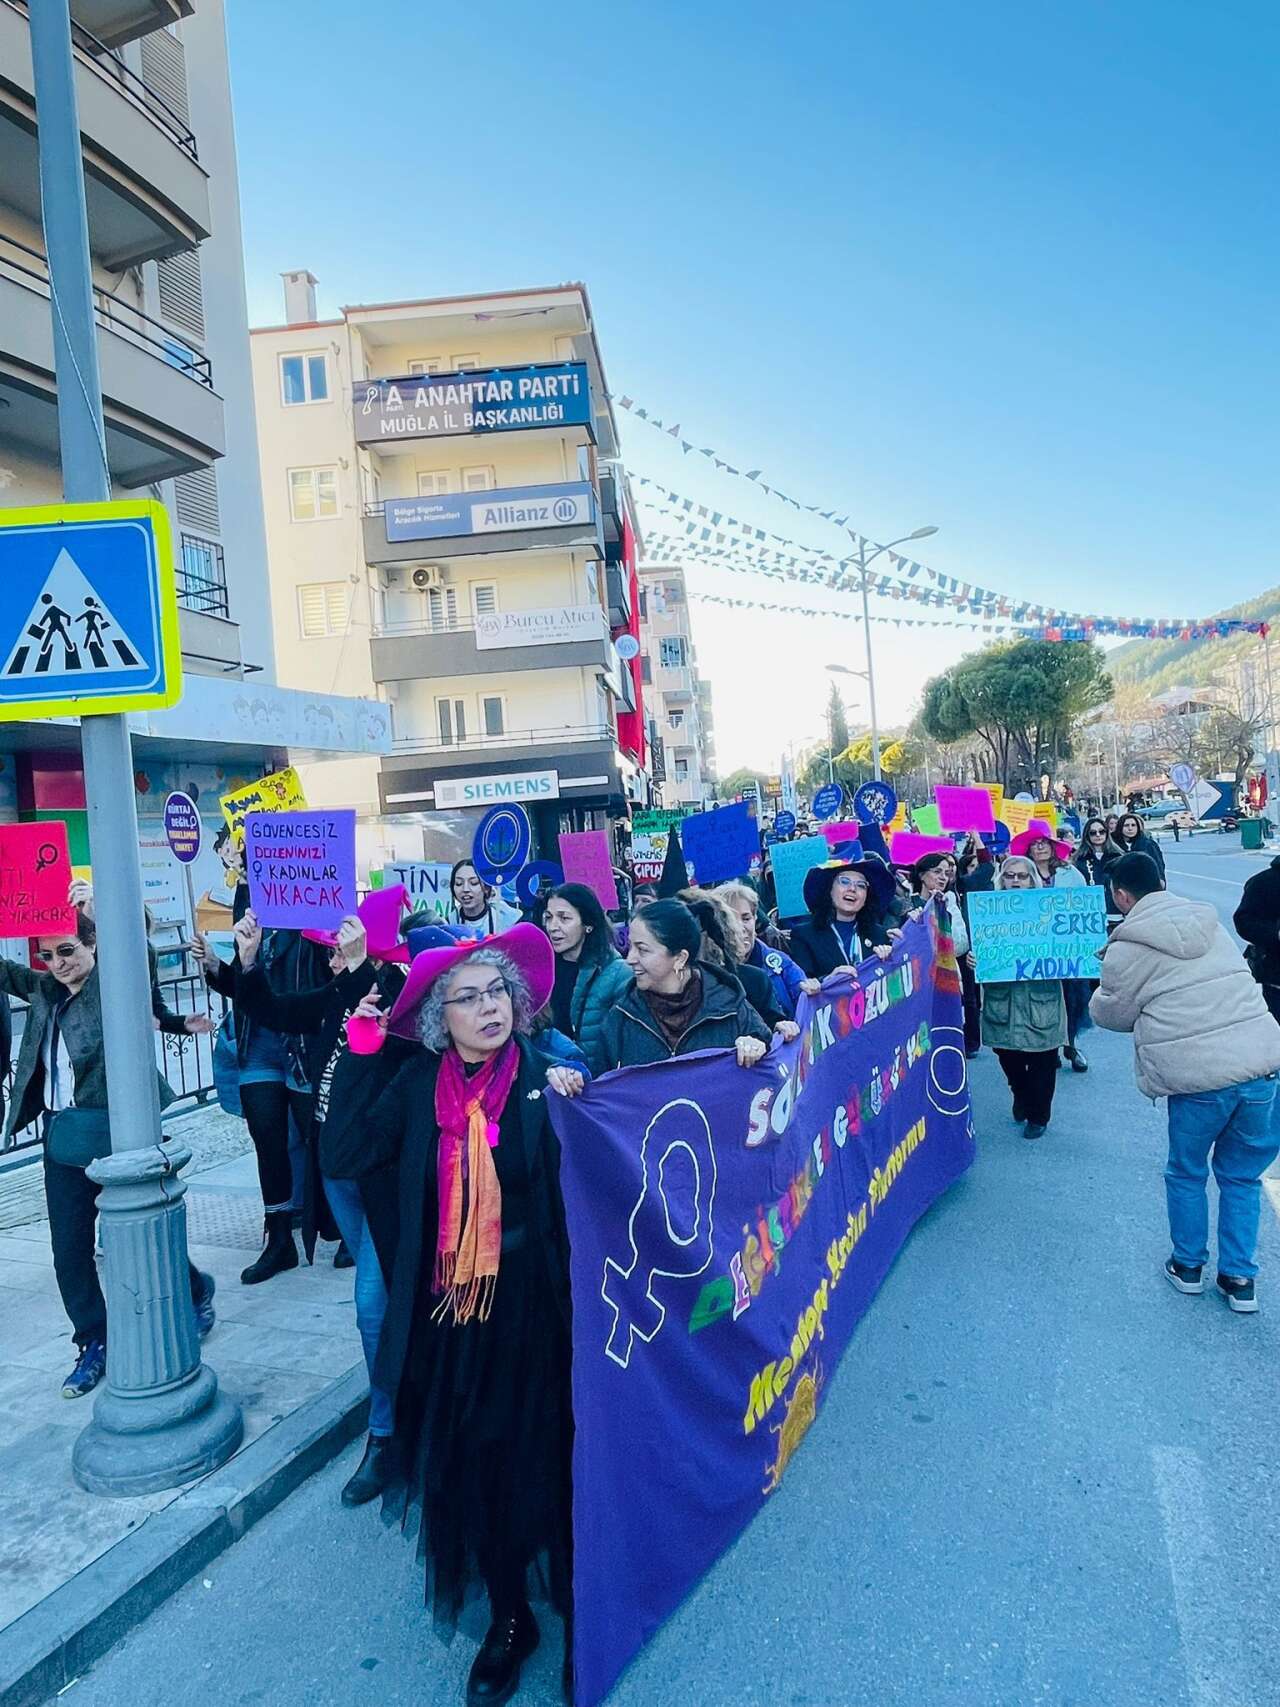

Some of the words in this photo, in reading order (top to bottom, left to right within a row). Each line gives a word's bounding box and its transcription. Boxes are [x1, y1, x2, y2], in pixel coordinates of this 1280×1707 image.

[414, 380, 513, 409] ANAHTAR
[519, 374, 580, 401] PARTİ
[380, 415, 439, 435] MUĞLA
[444, 410, 459, 429] İL
[463, 402, 564, 430] BAŞKANLIĞI
[484, 505, 549, 526] Allianz
[464, 777, 551, 800] SIEMENS
[269, 864, 339, 881] KADINLAR
[261, 882, 345, 910] YIKACAK
[1015, 956, 1083, 981] KADIN
